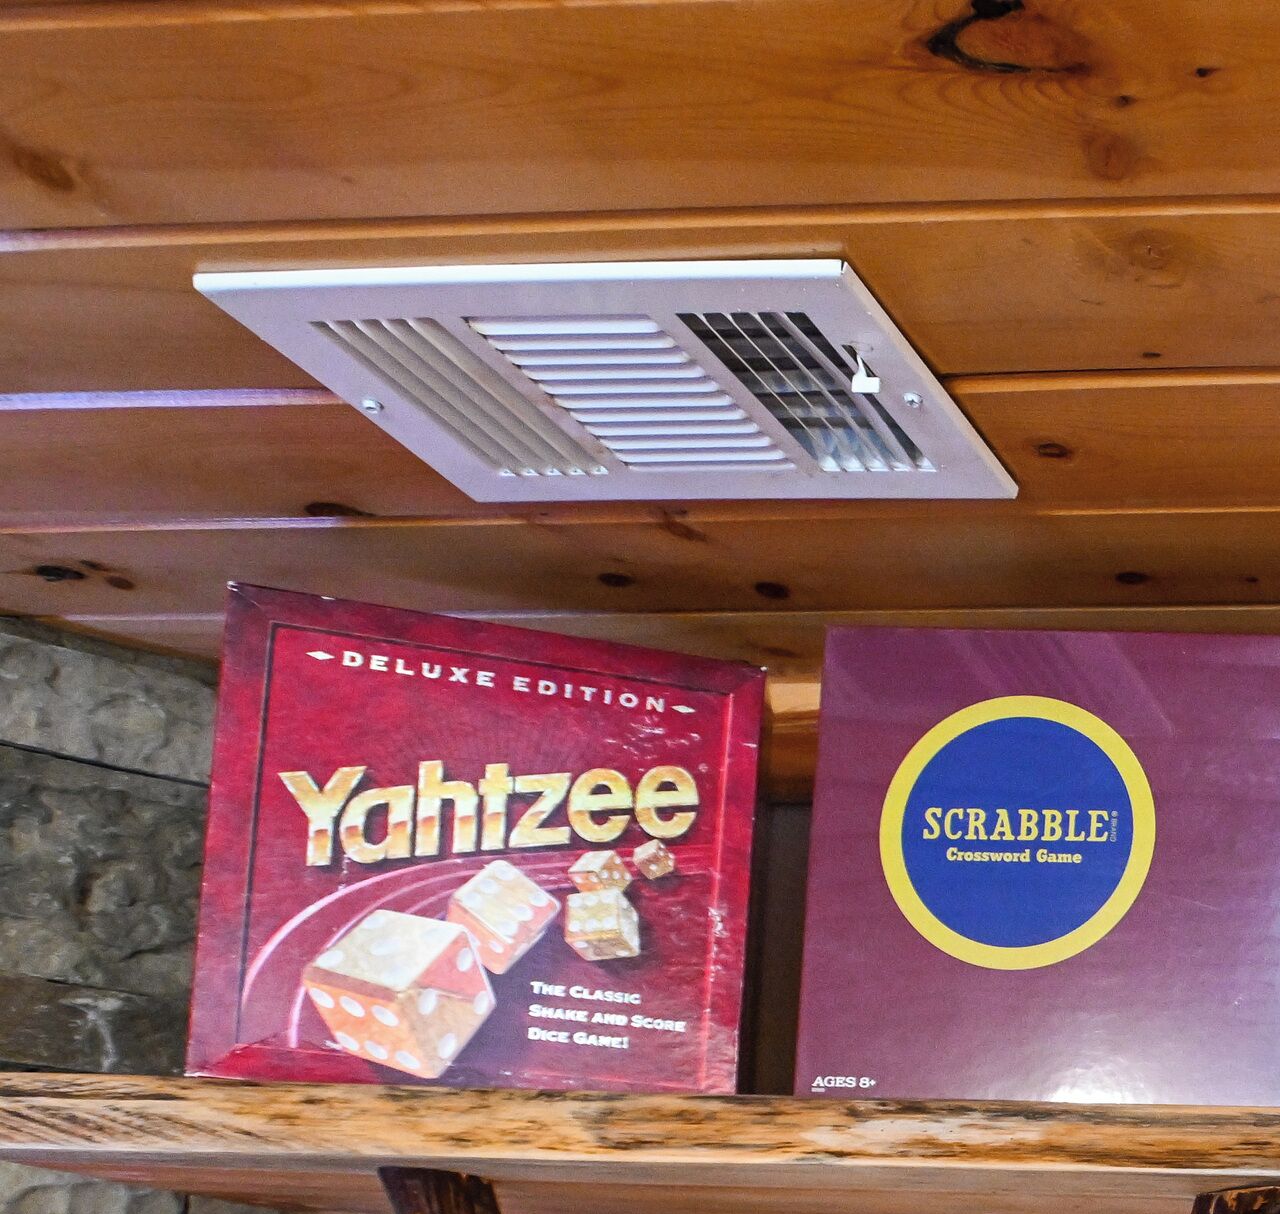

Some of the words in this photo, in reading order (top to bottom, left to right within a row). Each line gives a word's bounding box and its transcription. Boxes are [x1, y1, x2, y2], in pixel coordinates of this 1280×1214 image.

[341, 650, 495, 688] DELUXE
[512, 674, 666, 714] EDITION
[278, 760, 700, 867] Yahtzee
[922, 807, 1109, 842] SCRABBLE
[946, 847, 1030, 863] Crossword
[1036, 848, 1082, 864] Game
[530, 981, 566, 997] THE
[569, 985, 641, 1005] CLASSIC
[528, 1004, 589, 1022] SHAKE
[591, 1012, 628, 1026] AND
[630, 1015, 687, 1032] SCORE
[527, 1027, 570, 1043] DICE
[572, 1032, 630, 1049] GAME!
[811, 1076, 857, 1088] AGES
[859, 1077, 877, 1089] 8+
